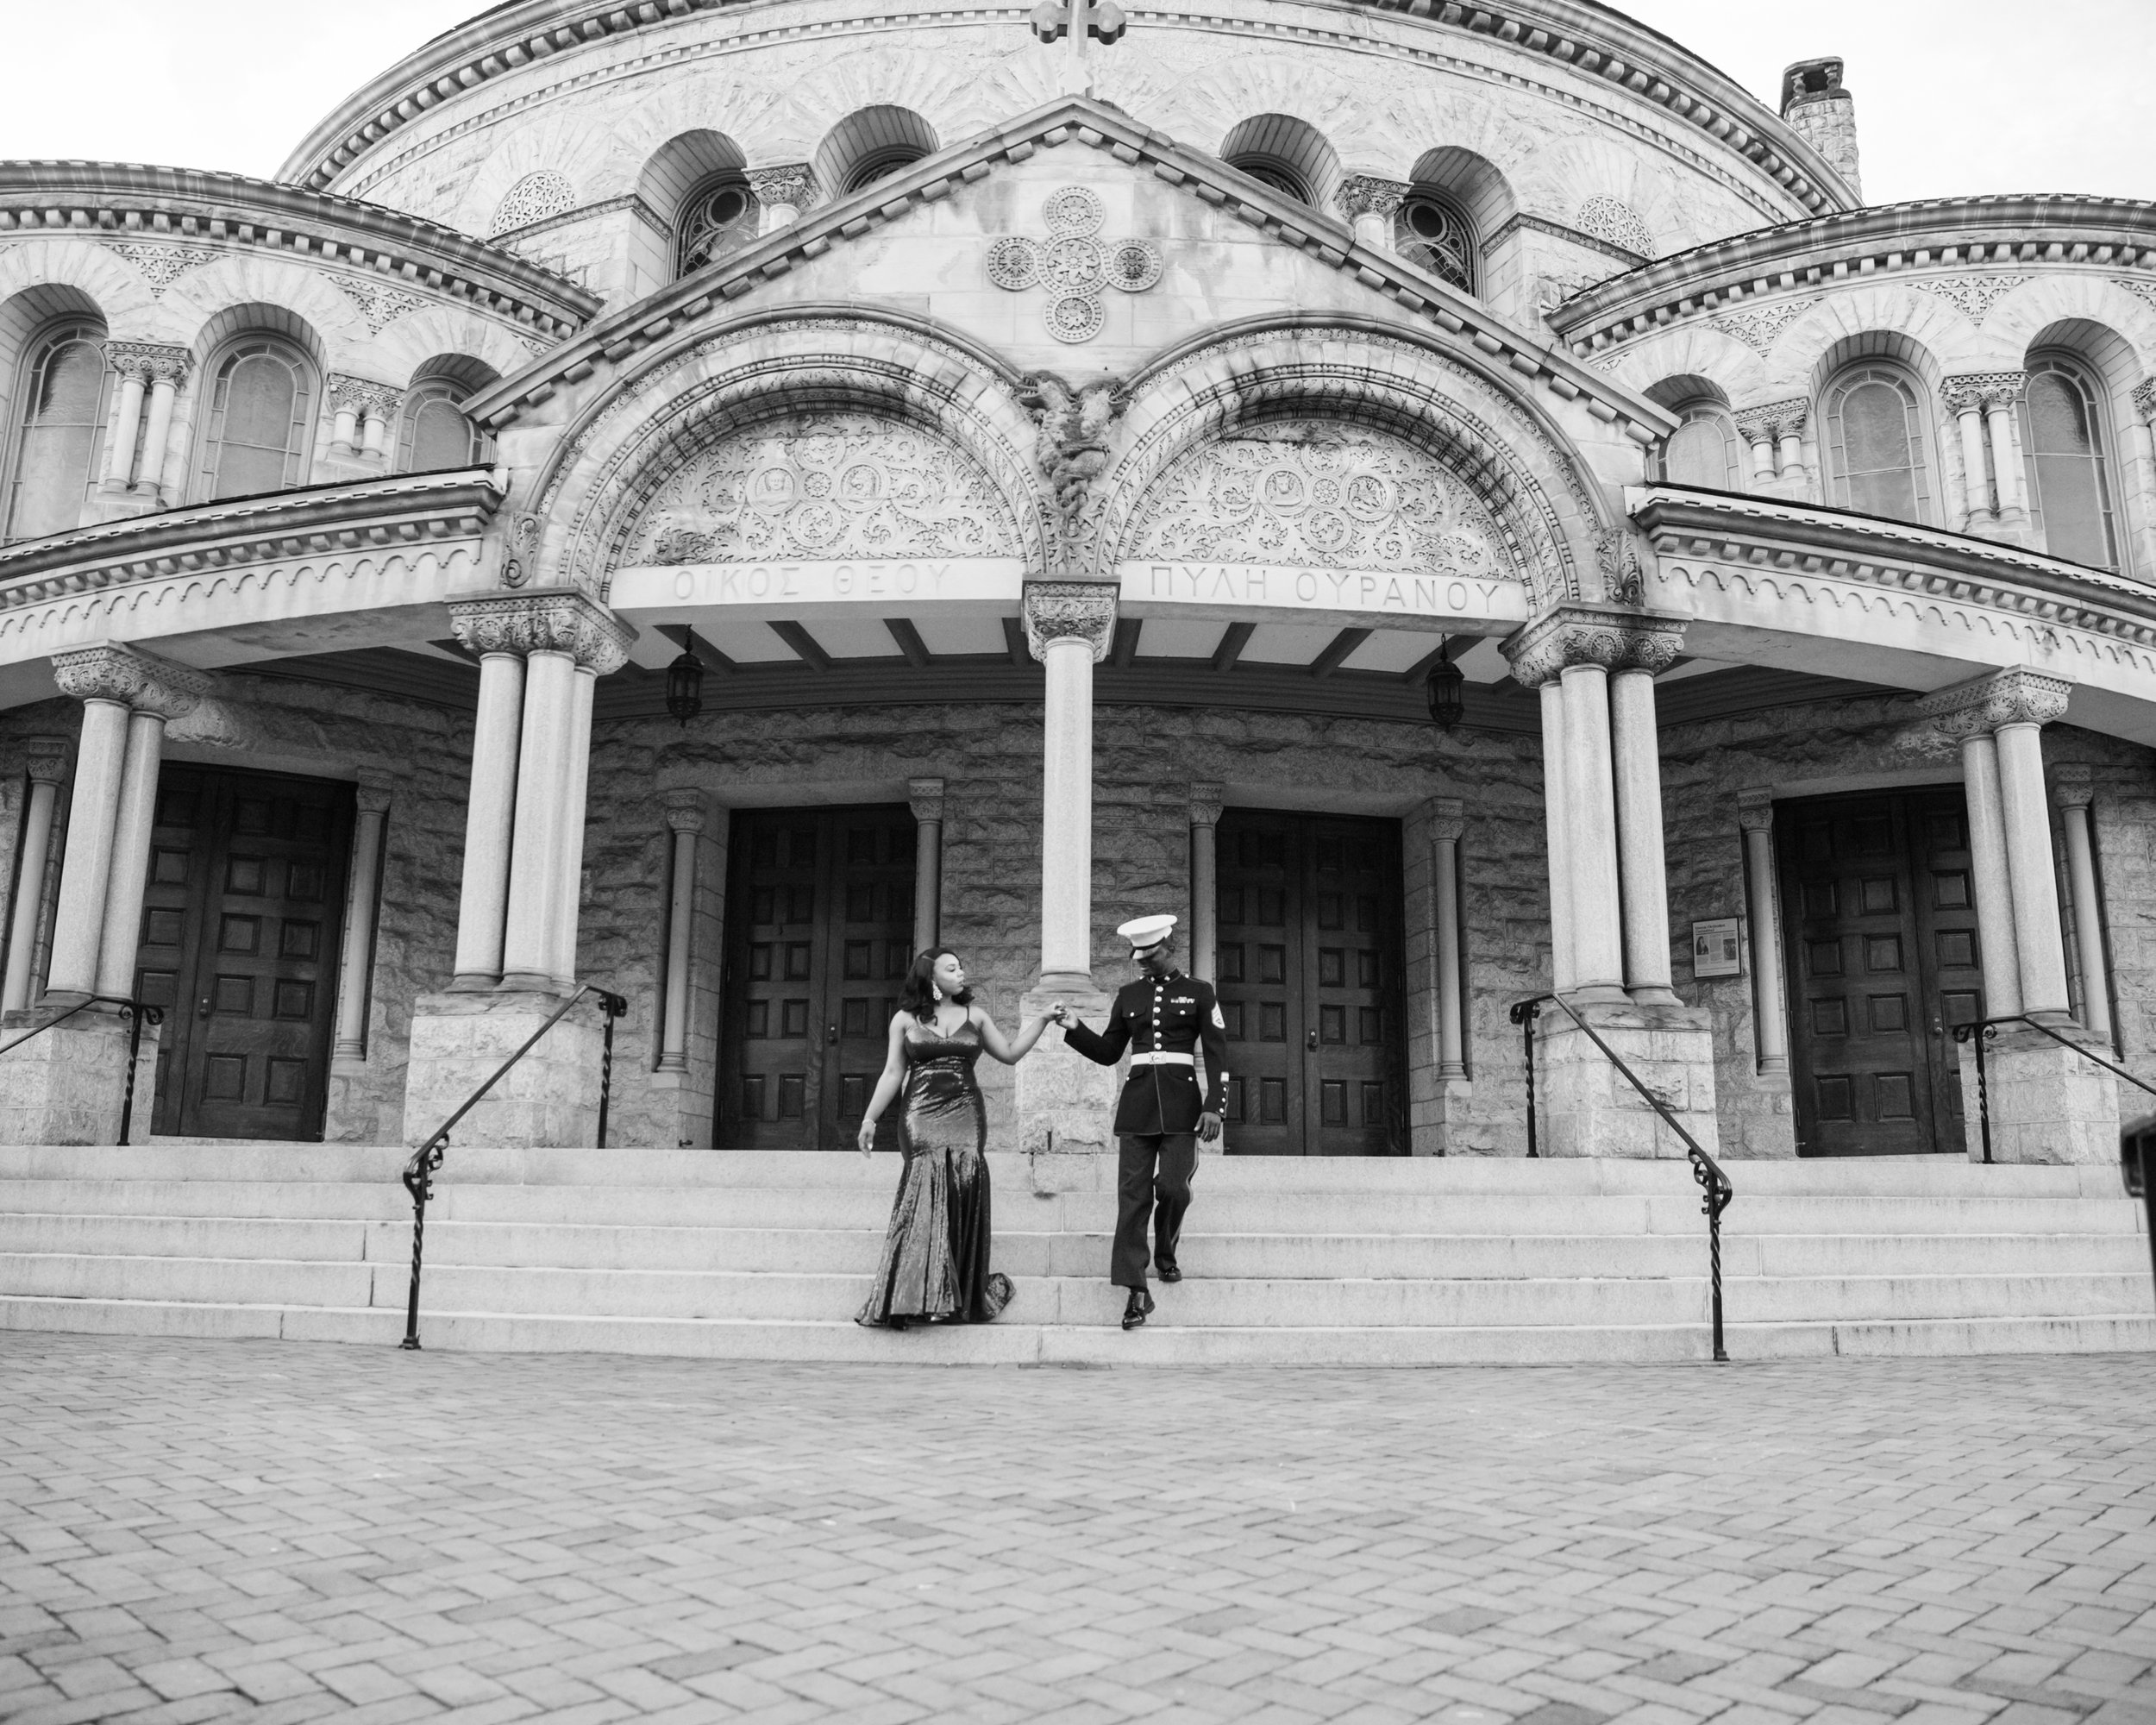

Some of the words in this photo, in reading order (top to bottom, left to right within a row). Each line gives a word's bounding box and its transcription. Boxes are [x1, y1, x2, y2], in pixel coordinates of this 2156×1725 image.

[673, 566, 800, 600] ΟΙΚΟΣ
[832, 562, 952, 596] ΘΕΟΥ
[1150, 566, 1267, 600] ΠΥΛΗ
[1295, 572, 1501, 613] ΟΥΡΑΝΟΥ
